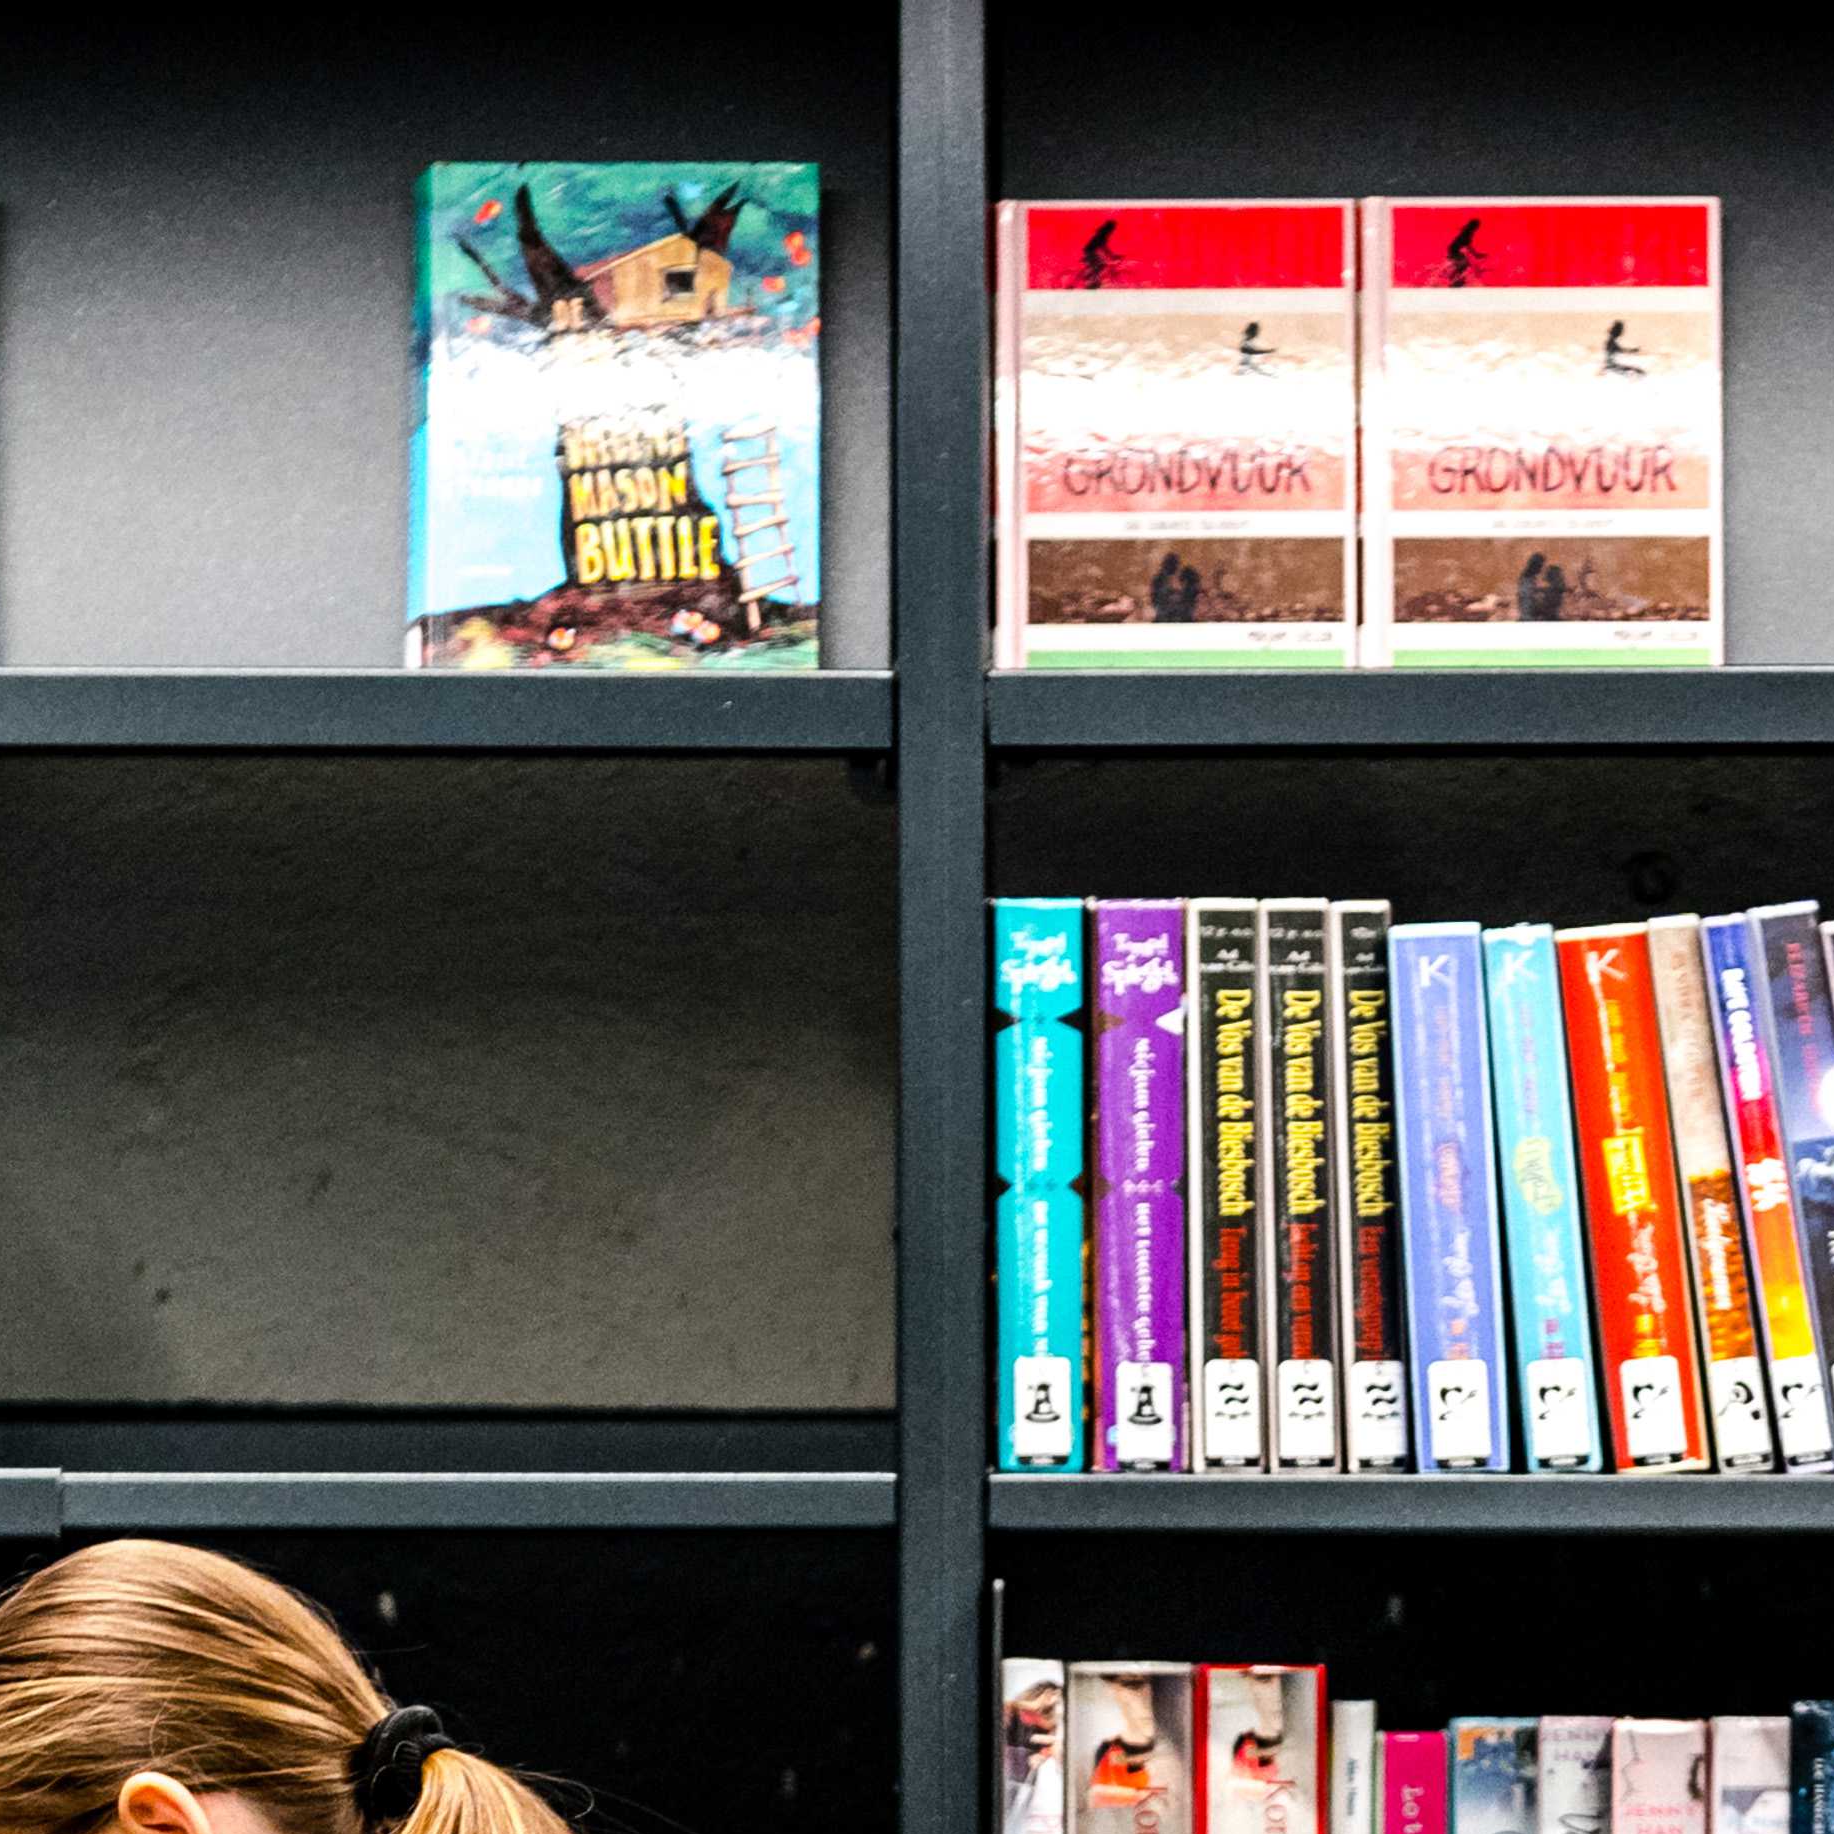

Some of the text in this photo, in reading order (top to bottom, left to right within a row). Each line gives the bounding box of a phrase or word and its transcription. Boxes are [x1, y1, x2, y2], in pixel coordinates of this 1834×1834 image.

[568, 460, 689, 522] MASON
[1061, 446, 1312, 497] GRONDVUUR
[1426, 443, 1679, 495] GRONDVUUR
[574, 515, 721, 585] BUTTLE
[1216, 988, 1256, 1217] De Vos van de Biesbosch
[1283, 988, 1325, 1217] De Vos van de Biesbosch
[1349, 988, 1395, 1217] De Vos van de Biesbosch
